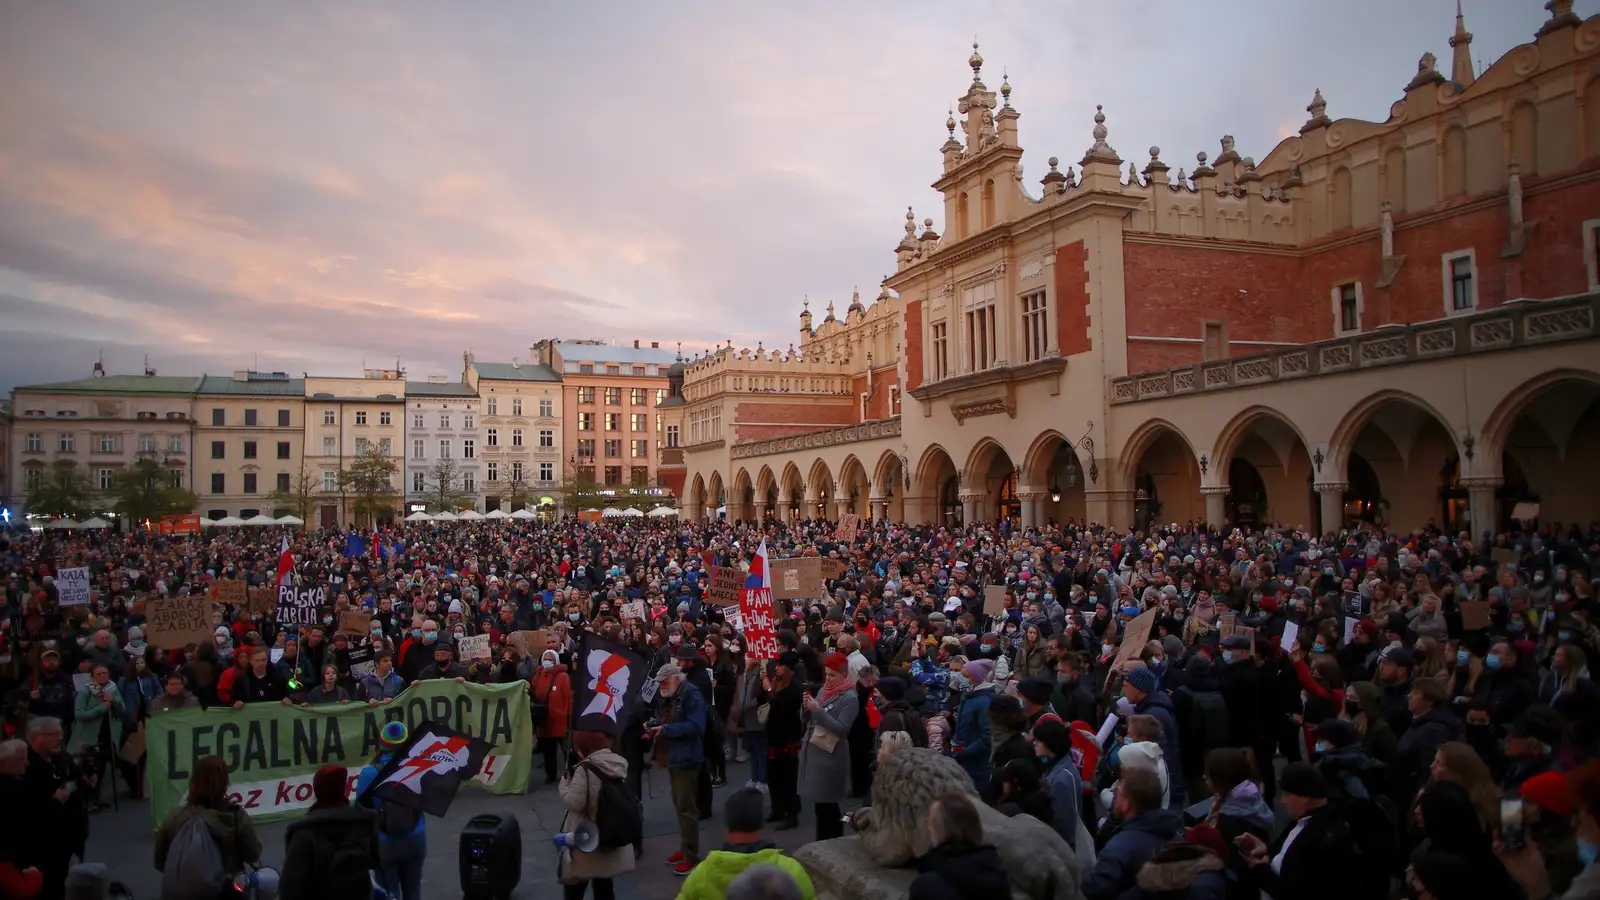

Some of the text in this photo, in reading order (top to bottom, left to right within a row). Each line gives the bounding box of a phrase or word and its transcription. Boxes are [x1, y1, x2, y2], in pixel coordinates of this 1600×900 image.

[60, 569, 86, 580] KAJA
[716, 569, 735, 579] ANI
[713, 580, 743, 590] JEDNEJ
[279, 585, 325, 608] POLSKA
[746, 589, 772, 608] #ANI
[155, 598, 205, 612] ZAKAZ
[152, 608, 204, 621] ABORCJI
[276, 607, 318, 624] ZABIJA
[741, 609, 776, 633] JEDNEJ
[155, 620, 209, 632] ZABIJA
[168, 716, 346, 780] LEGALNA
